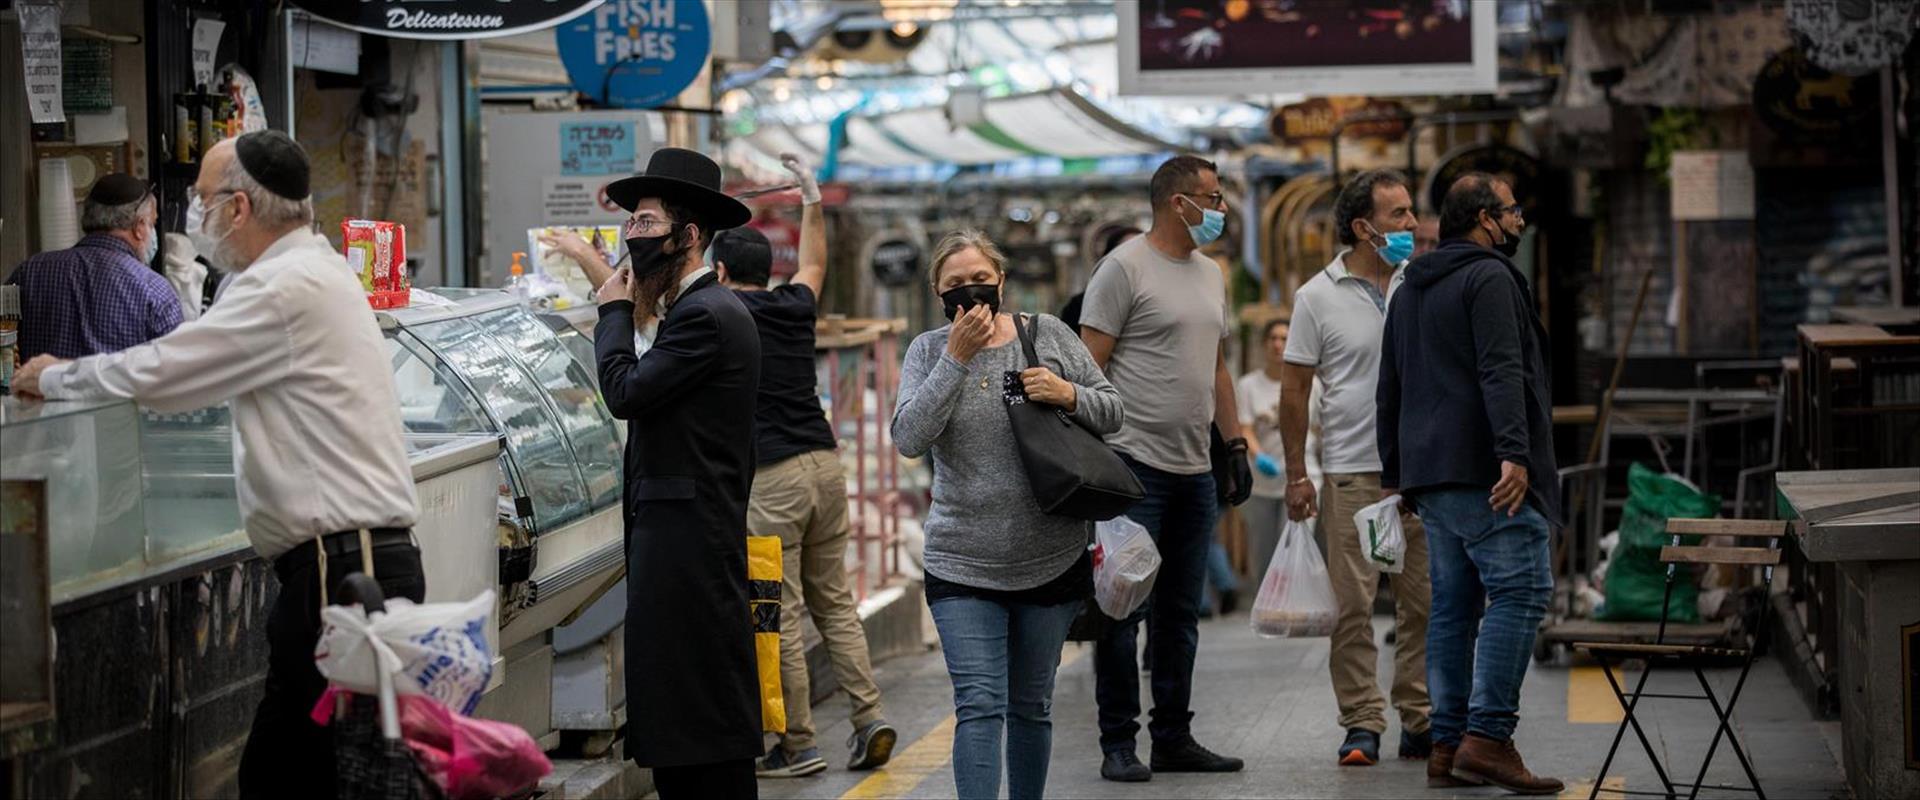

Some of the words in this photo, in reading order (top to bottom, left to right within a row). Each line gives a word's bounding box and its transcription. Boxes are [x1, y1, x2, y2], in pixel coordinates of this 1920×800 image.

[386, 7, 505, 30] Delicatessen
[595, 0, 675, 28] FISH
[595, 30, 676, 65] FRIES
